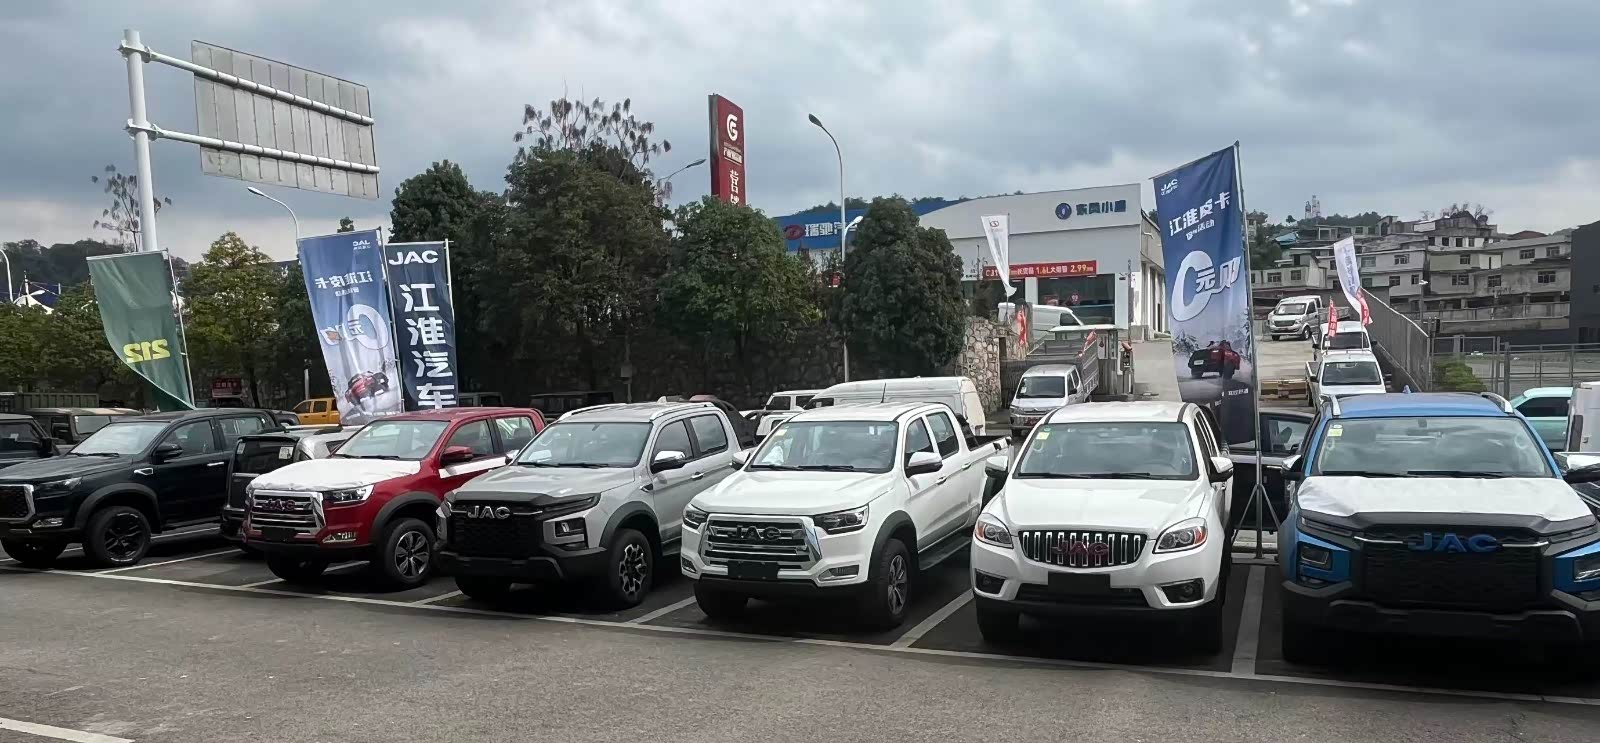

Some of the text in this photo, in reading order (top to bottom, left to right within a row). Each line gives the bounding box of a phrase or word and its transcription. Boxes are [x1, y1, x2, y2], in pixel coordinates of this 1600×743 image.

[1160, 179, 1178, 191] JAC
[1169, 191, 1230, 236] 江淮皮卡
[388, 250, 438, 265] JAC
[399, 283, 457, 409] 江淮汽车
[262, 499, 295, 511] JAC
[467, 506, 510, 519] JAC
[728, 525, 781, 541] JAC
[1051, 541, 1109, 555] JAC
[1408, 533, 1497, 553] JAC
